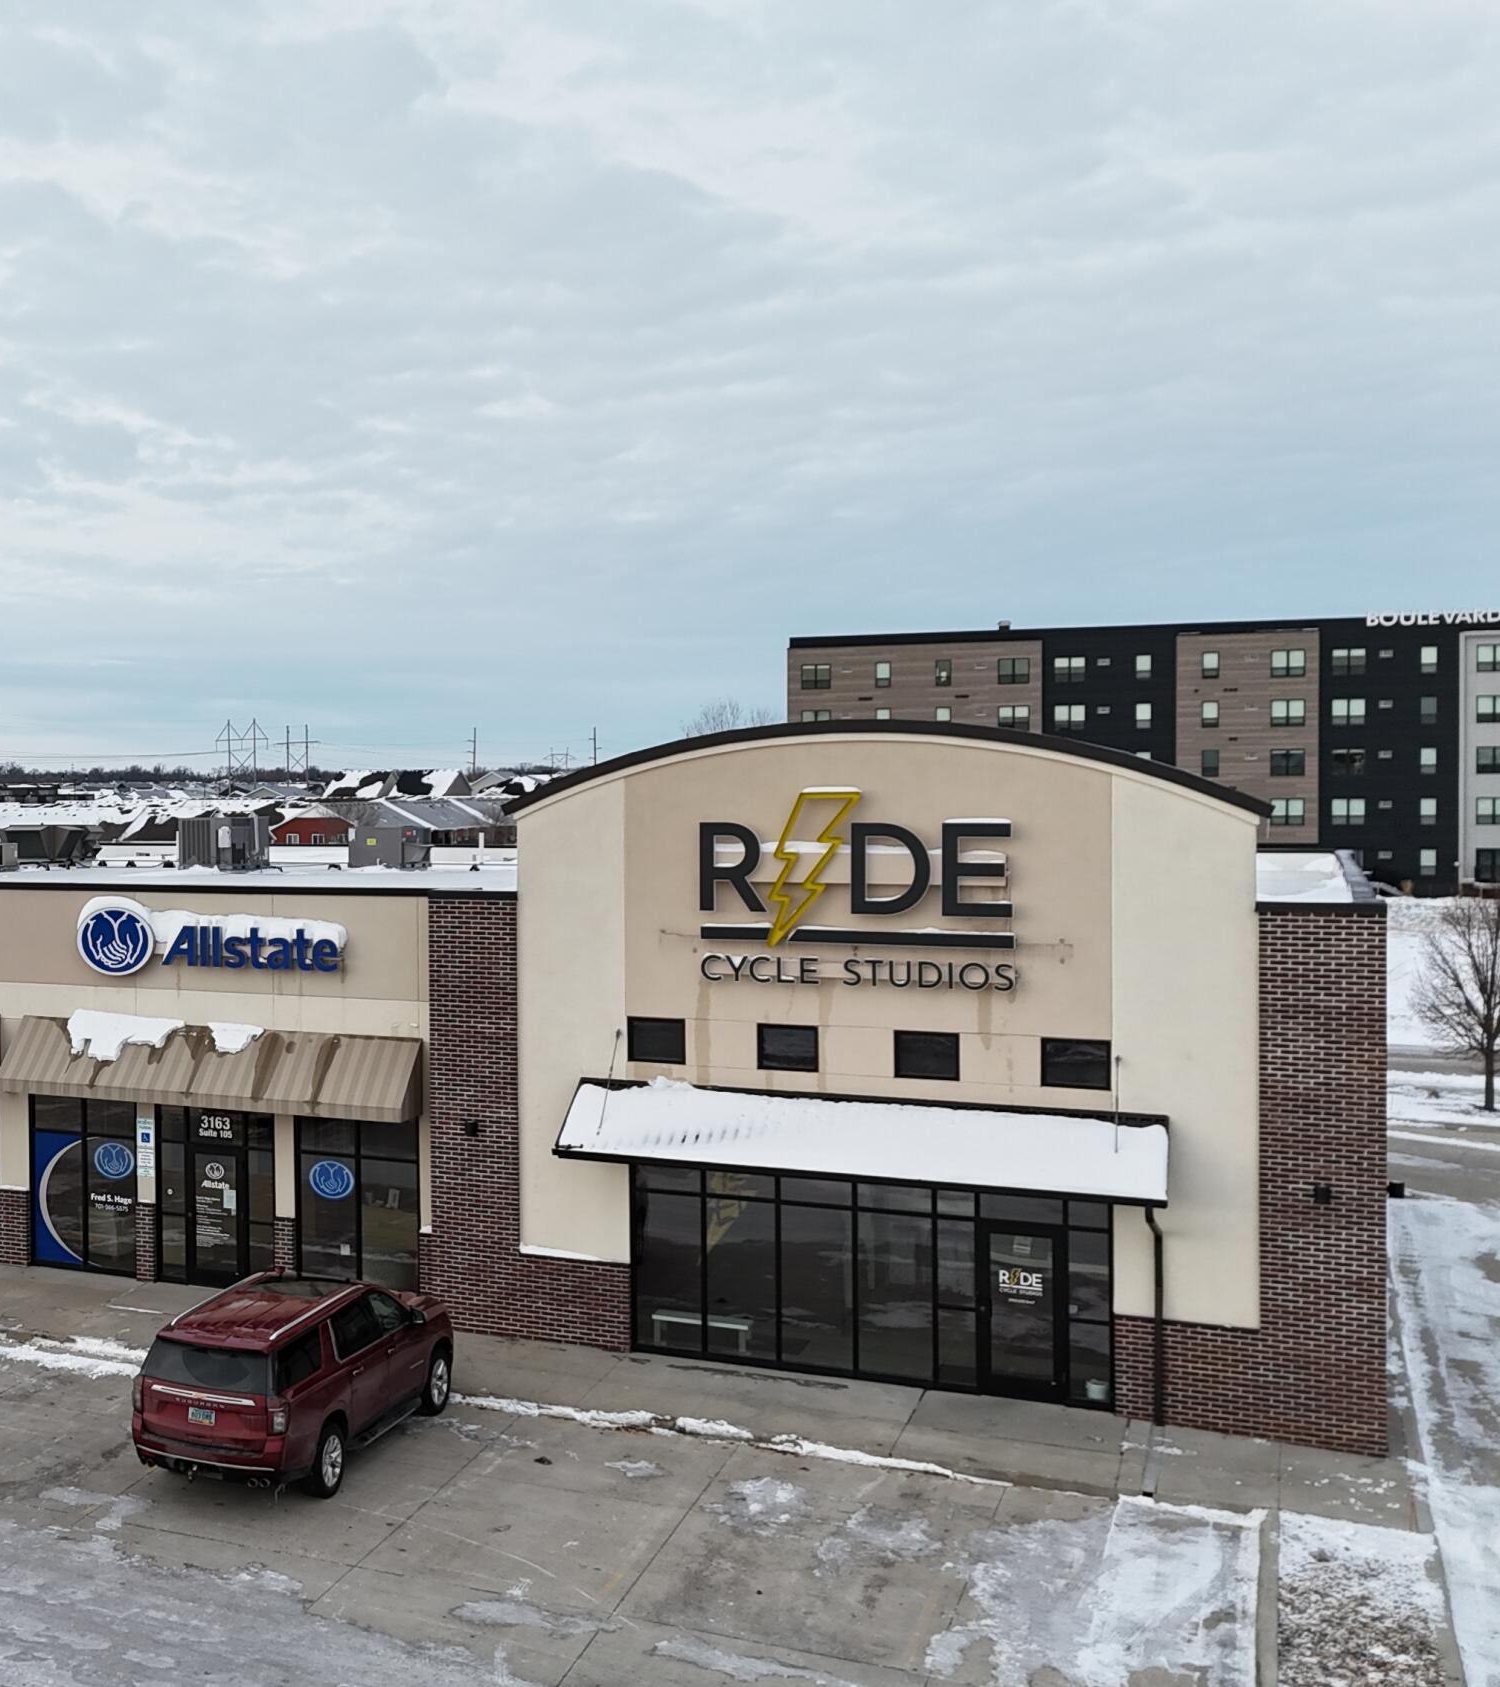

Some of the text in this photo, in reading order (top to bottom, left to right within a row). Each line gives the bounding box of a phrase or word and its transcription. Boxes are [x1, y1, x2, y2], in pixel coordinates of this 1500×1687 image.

[161, 925, 340, 972] Allstate
[700, 954, 1016, 992] CYCLE STUDIOS
[200, 1115, 231, 1130] 3163
[198, 1128, 233, 1139] Suite 105
[201, 1179, 231, 1191] Allstate
[90, 1192, 106, 1202] Fred
[106, 1194, 114, 1202] S.
